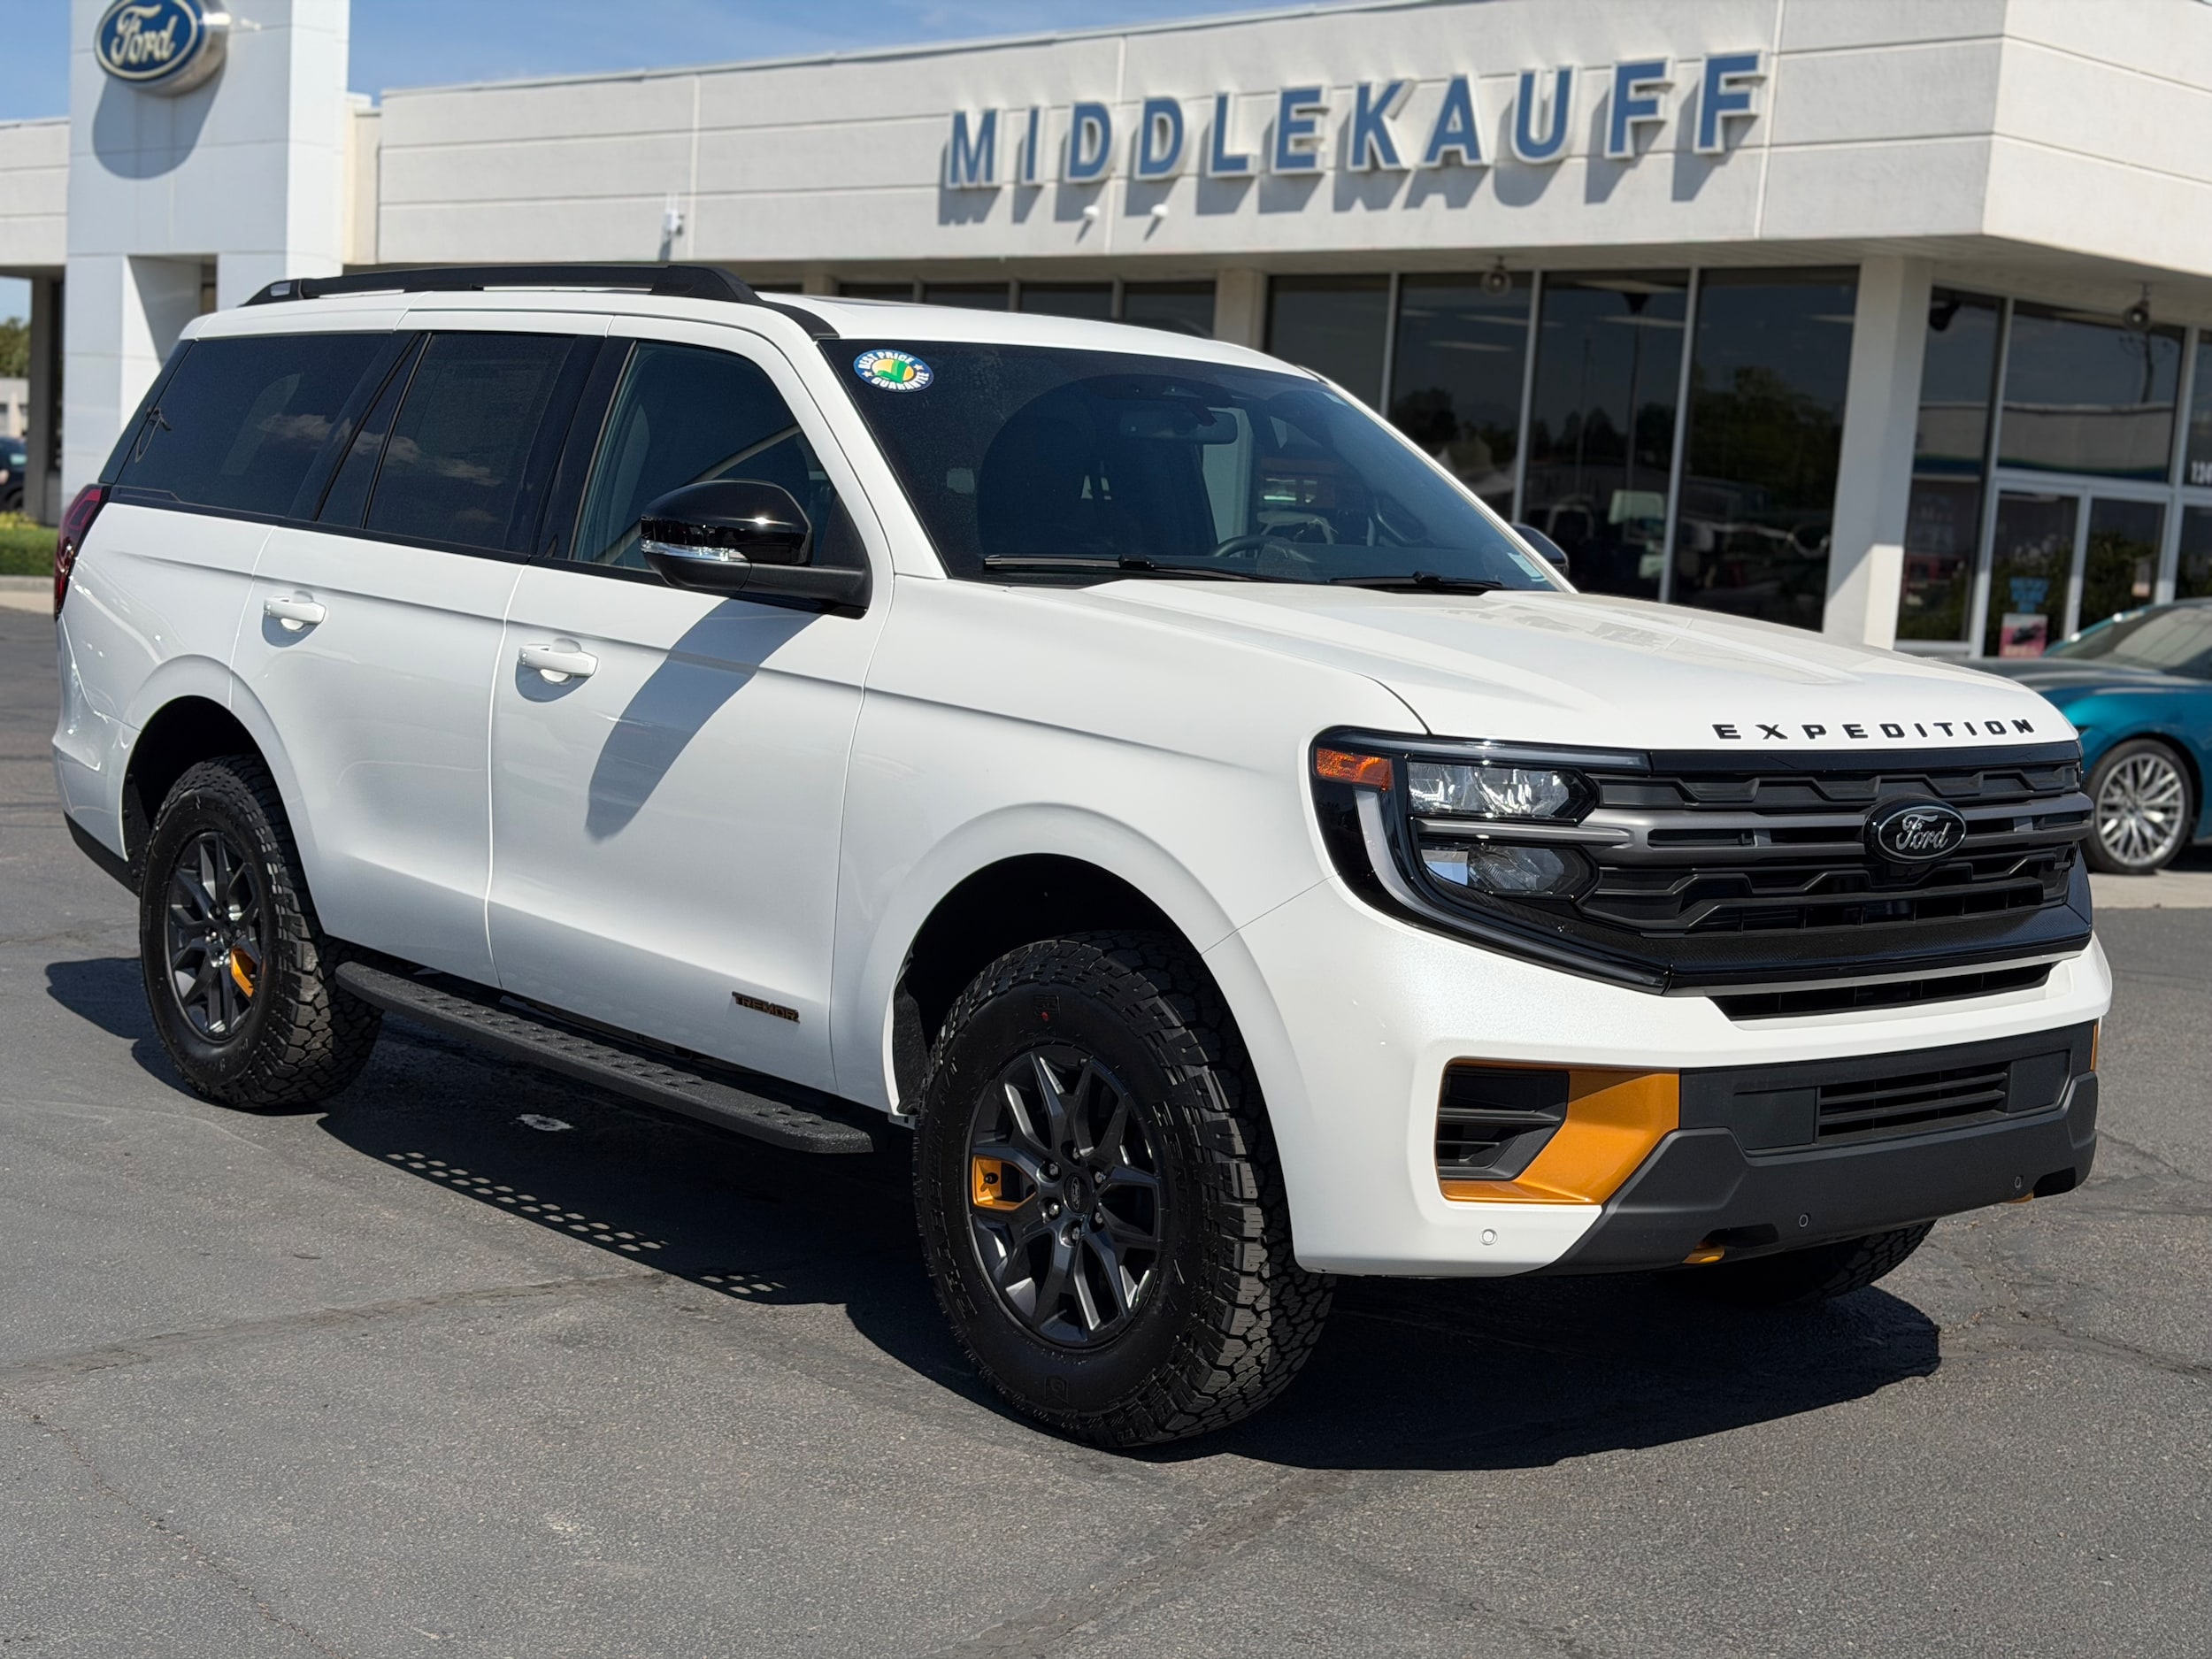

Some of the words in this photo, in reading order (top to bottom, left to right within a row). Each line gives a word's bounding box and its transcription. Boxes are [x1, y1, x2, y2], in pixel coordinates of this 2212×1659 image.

[110, 4, 178, 66] Ford
[945, 50, 1766, 188] MIDDLEKAUFF
[857, 353, 879, 370] BEST
[876, 351, 915, 365] PRICE
[871, 371, 930, 390] GUARANTEE
[1711, 718, 2035, 740] EXPEDITION
[1895, 814, 1949, 850] Ford
[732, 991, 801, 1024] TREMOR
